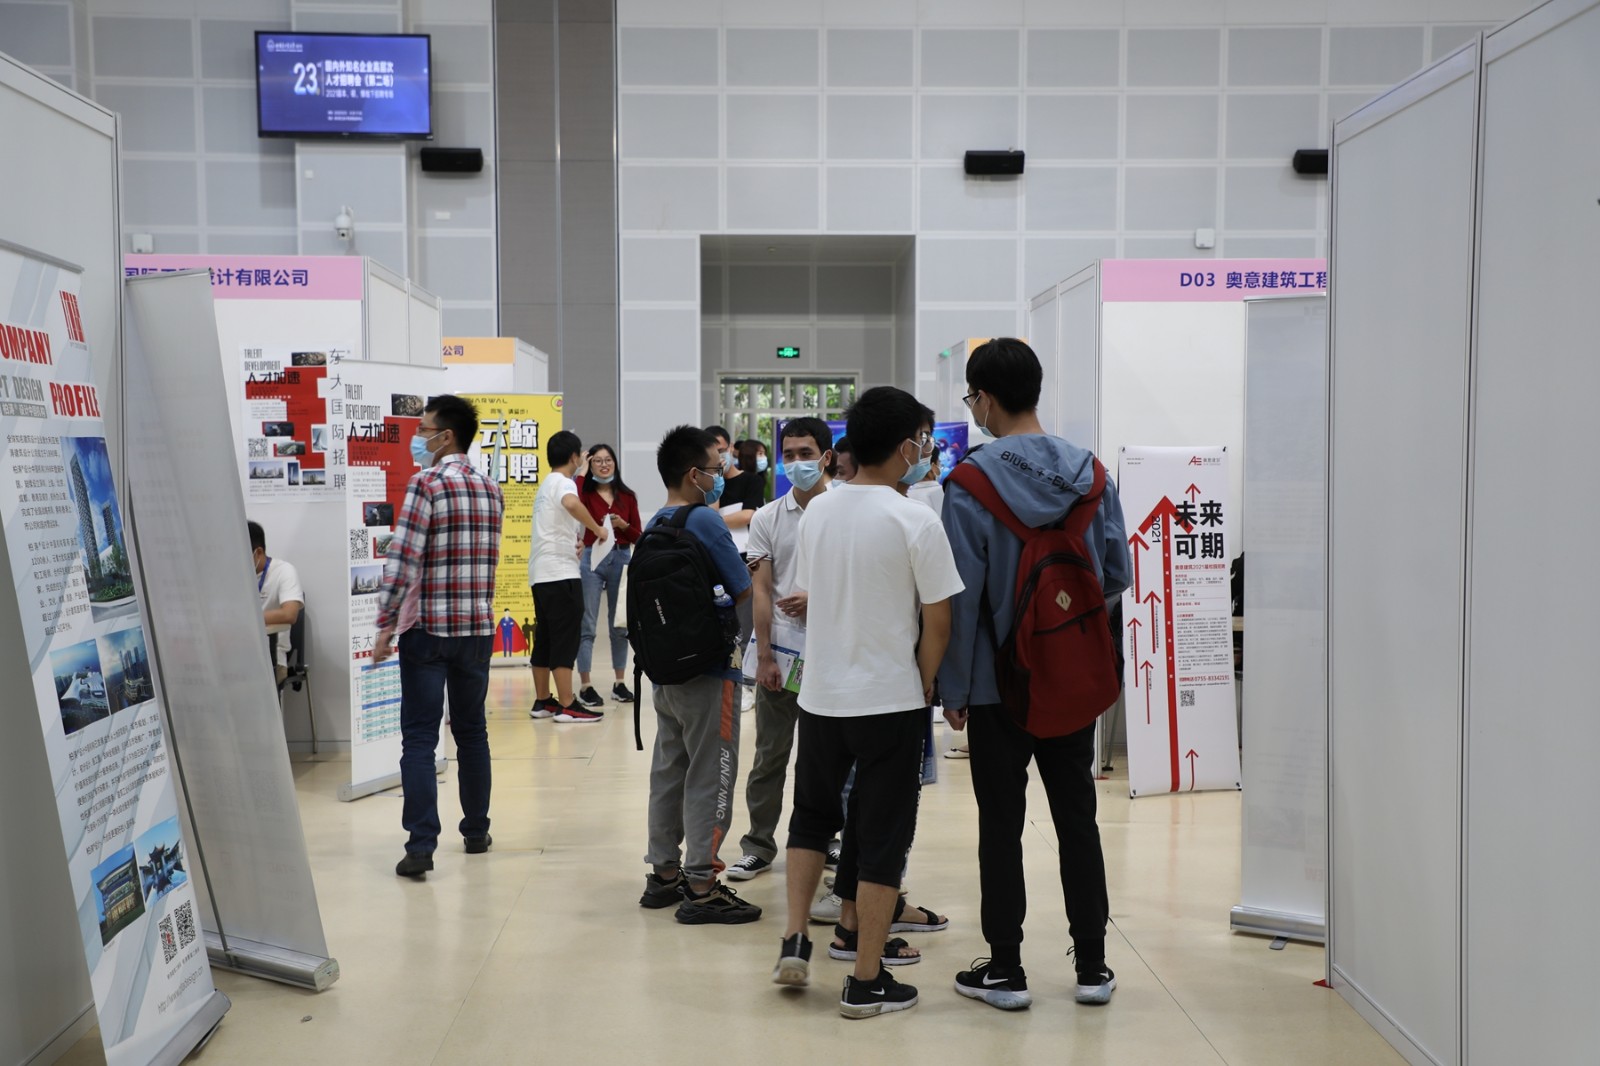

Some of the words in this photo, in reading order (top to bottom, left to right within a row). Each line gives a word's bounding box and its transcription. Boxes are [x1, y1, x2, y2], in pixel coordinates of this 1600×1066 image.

[293, 62, 318, 95] 23
[1180, 272, 1215, 287] D03
[244, 348, 263, 359] TALENT
[443, 345, 464, 356] 公司
[244, 360, 281, 371] DEVELOPMENT
[247, 371, 300, 385] 人才加速
[12, 375, 45, 402] DESIGN
[49, 381, 101, 418] PROFILE
[345, 384, 363, 401] TALENT
[346, 404, 381, 421] DEVELOPMENT
[347, 421, 400, 444] 人才加速
[480, 418, 539, 450] 云鲸
[480, 453, 539, 484] 招聘
[1174, 500, 1224, 528] 未来
[1151, 515, 1161, 543] 2021
[1174, 532, 1225, 560] 可期
